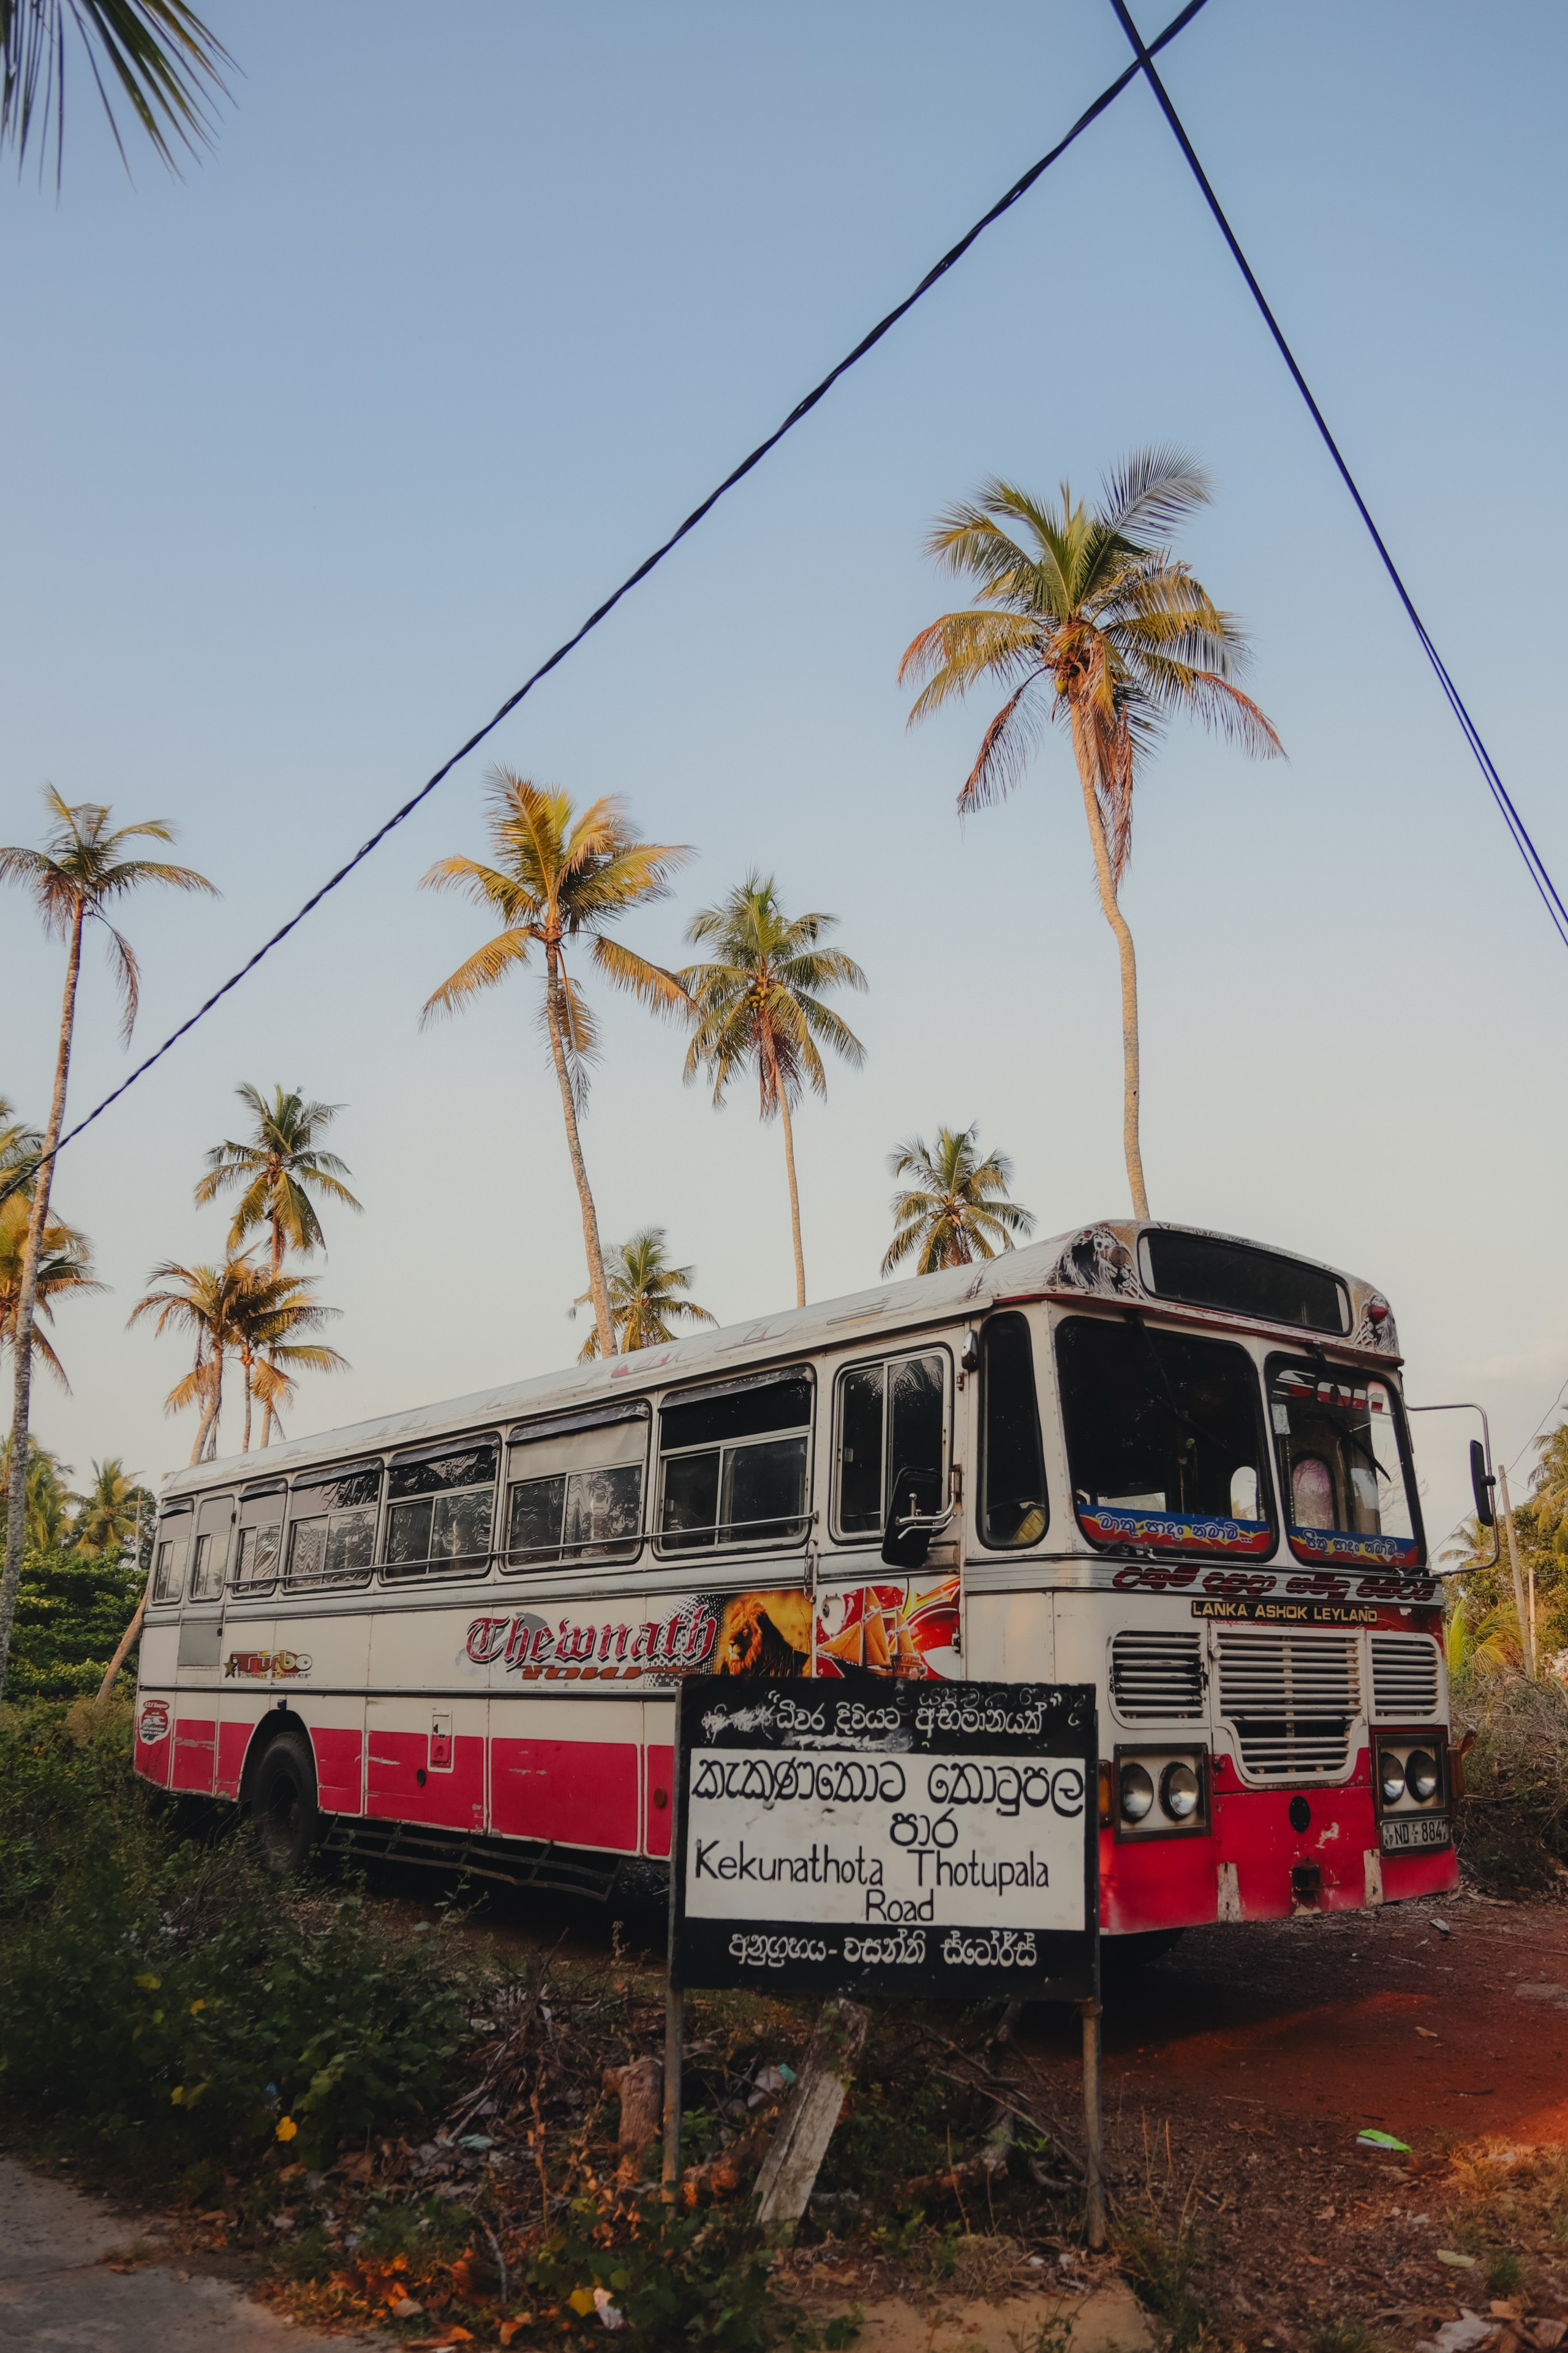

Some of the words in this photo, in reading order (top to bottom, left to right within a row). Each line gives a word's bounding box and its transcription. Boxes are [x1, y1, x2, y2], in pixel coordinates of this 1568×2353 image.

[1193, 1602, 1248, 1616] LANKA
[1255, 1604, 1308, 1619] ASHOK
[1314, 1607, 1377, 1622] LEYLAND
[466, 1604, 718, 1672] Thewnath
[231, 1650, 312, 1672] Turbo
[835, 1701, 901, 1735] දිවියට
[927, 1762, 1084, 1818] තොටුපල
[890, 1808, 959, 1848] පාර
[695, 1840, 883, 1886] Kekunathota
[907, 1849, 1049, 1896] Thotupala
[865, 1889, 934, 1922] Road
